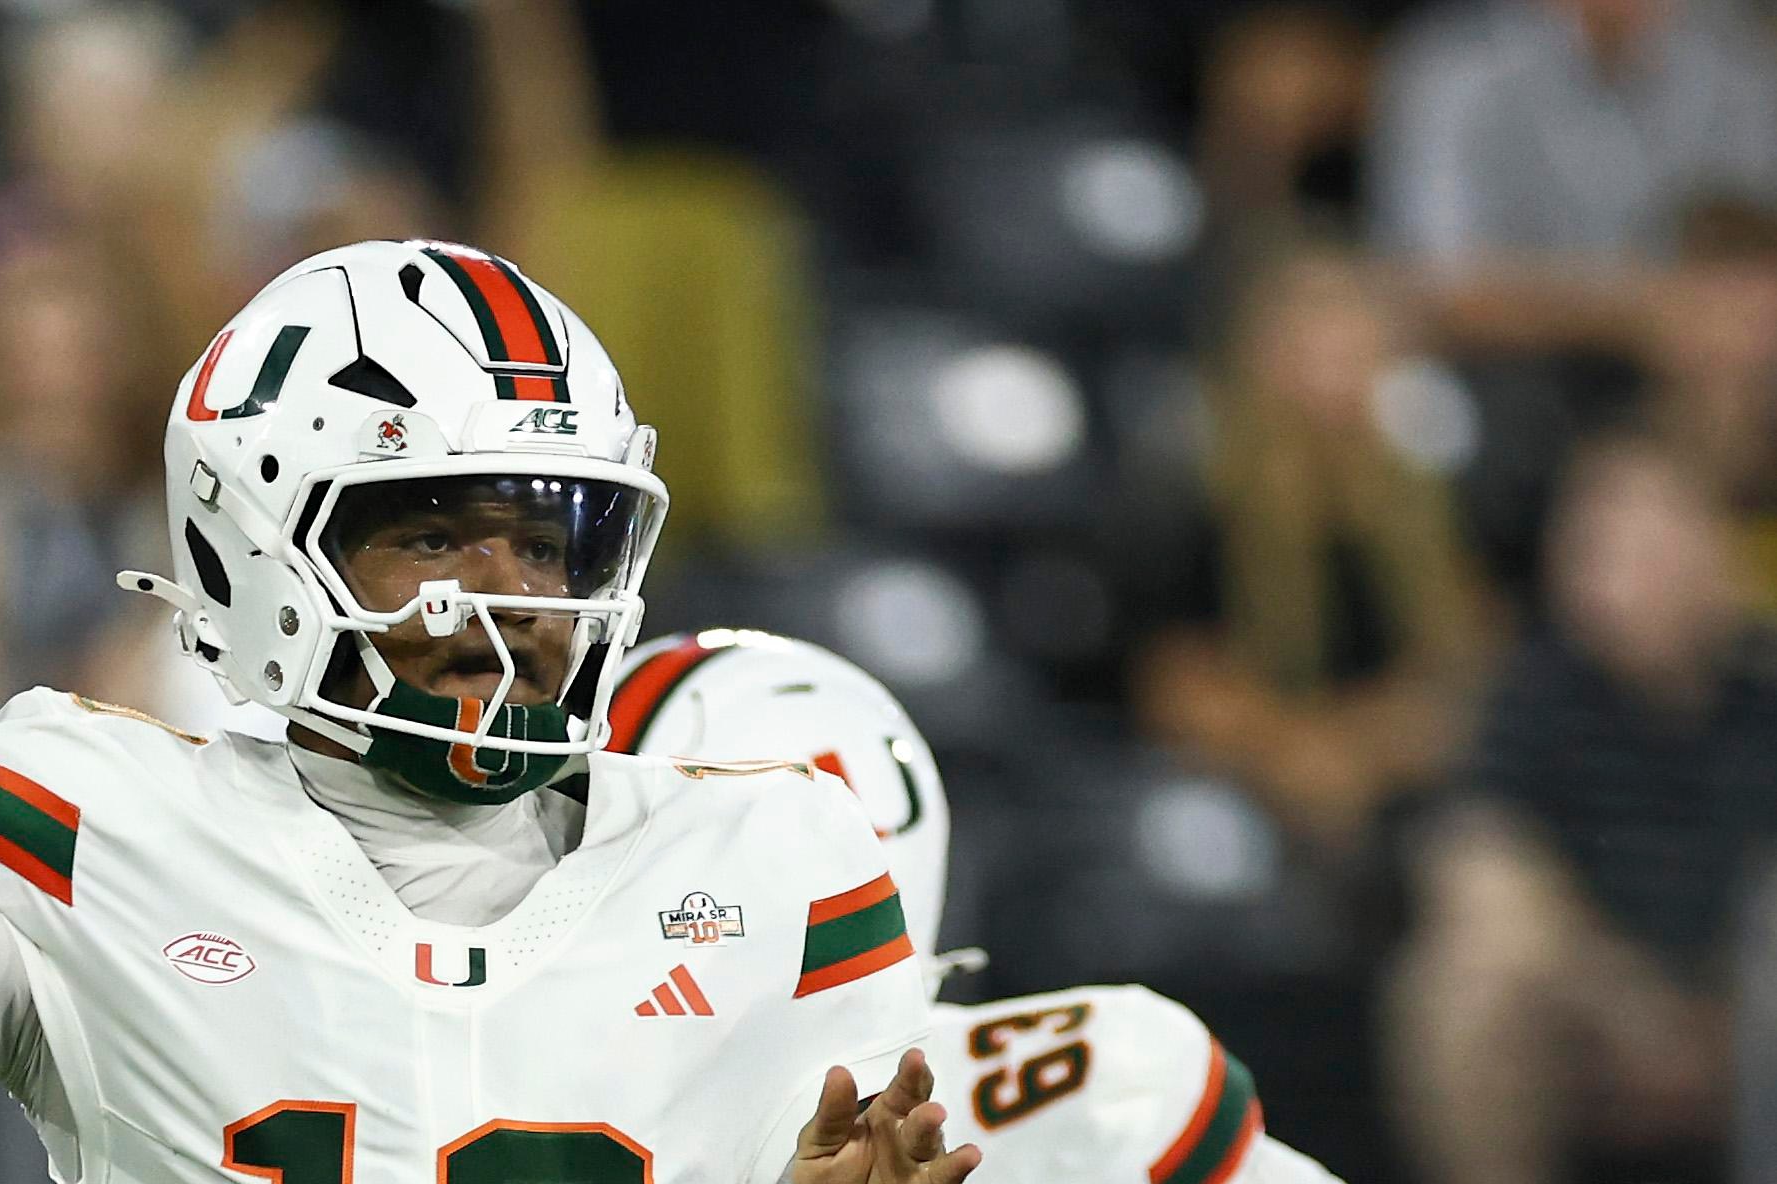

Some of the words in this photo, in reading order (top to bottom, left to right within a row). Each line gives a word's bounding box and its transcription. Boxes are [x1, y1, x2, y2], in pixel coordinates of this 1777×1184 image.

[512, 407, 579, 432] ACC
[669, 911, 705, 923] MIRA
[688, 920, 720, 944] 10
[176, 945, 245, 968] ACC
[415, 942, 487, 986] U
[970, 1001, 1092, 1131] 63
